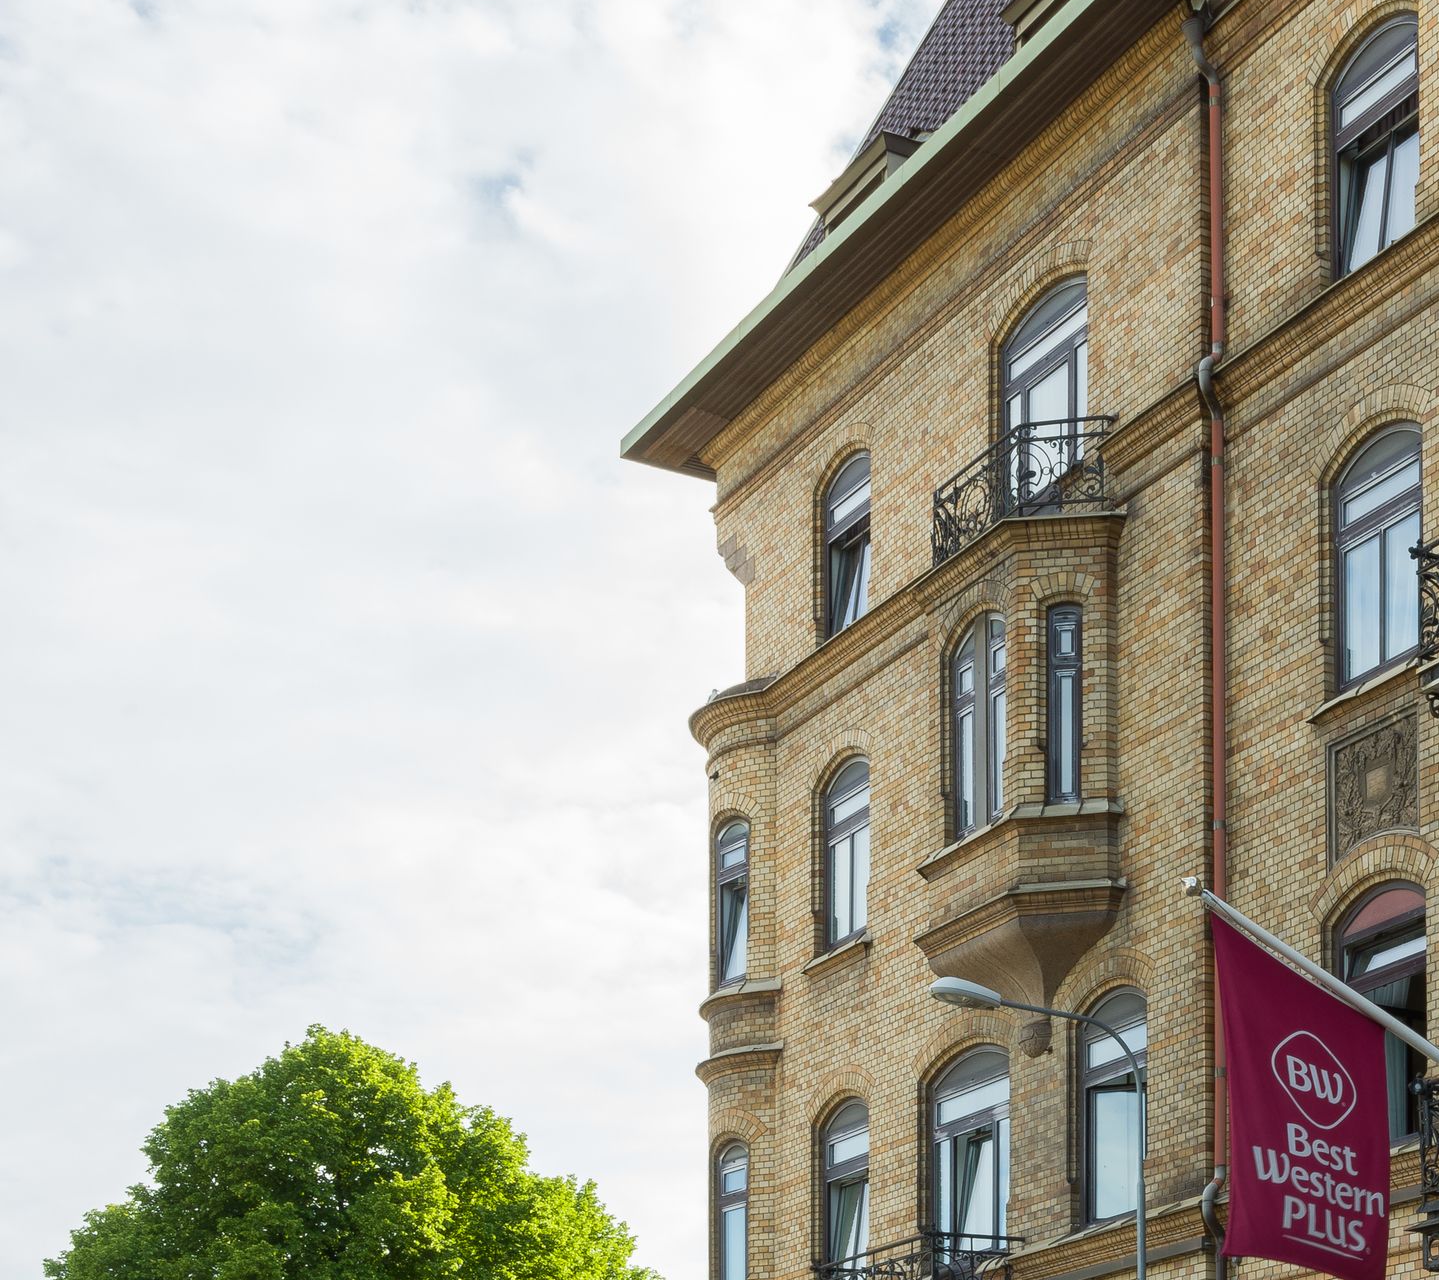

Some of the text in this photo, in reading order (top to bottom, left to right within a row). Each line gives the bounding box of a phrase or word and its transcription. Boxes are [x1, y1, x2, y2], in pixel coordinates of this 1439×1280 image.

[1286, 1055, 1343, 1105] BW
[1287, 1123, 1359, 1176] Best
[1252, 1146, 1385, 1218] Western
[1282, 1195, 1366, 1252] PLUS
